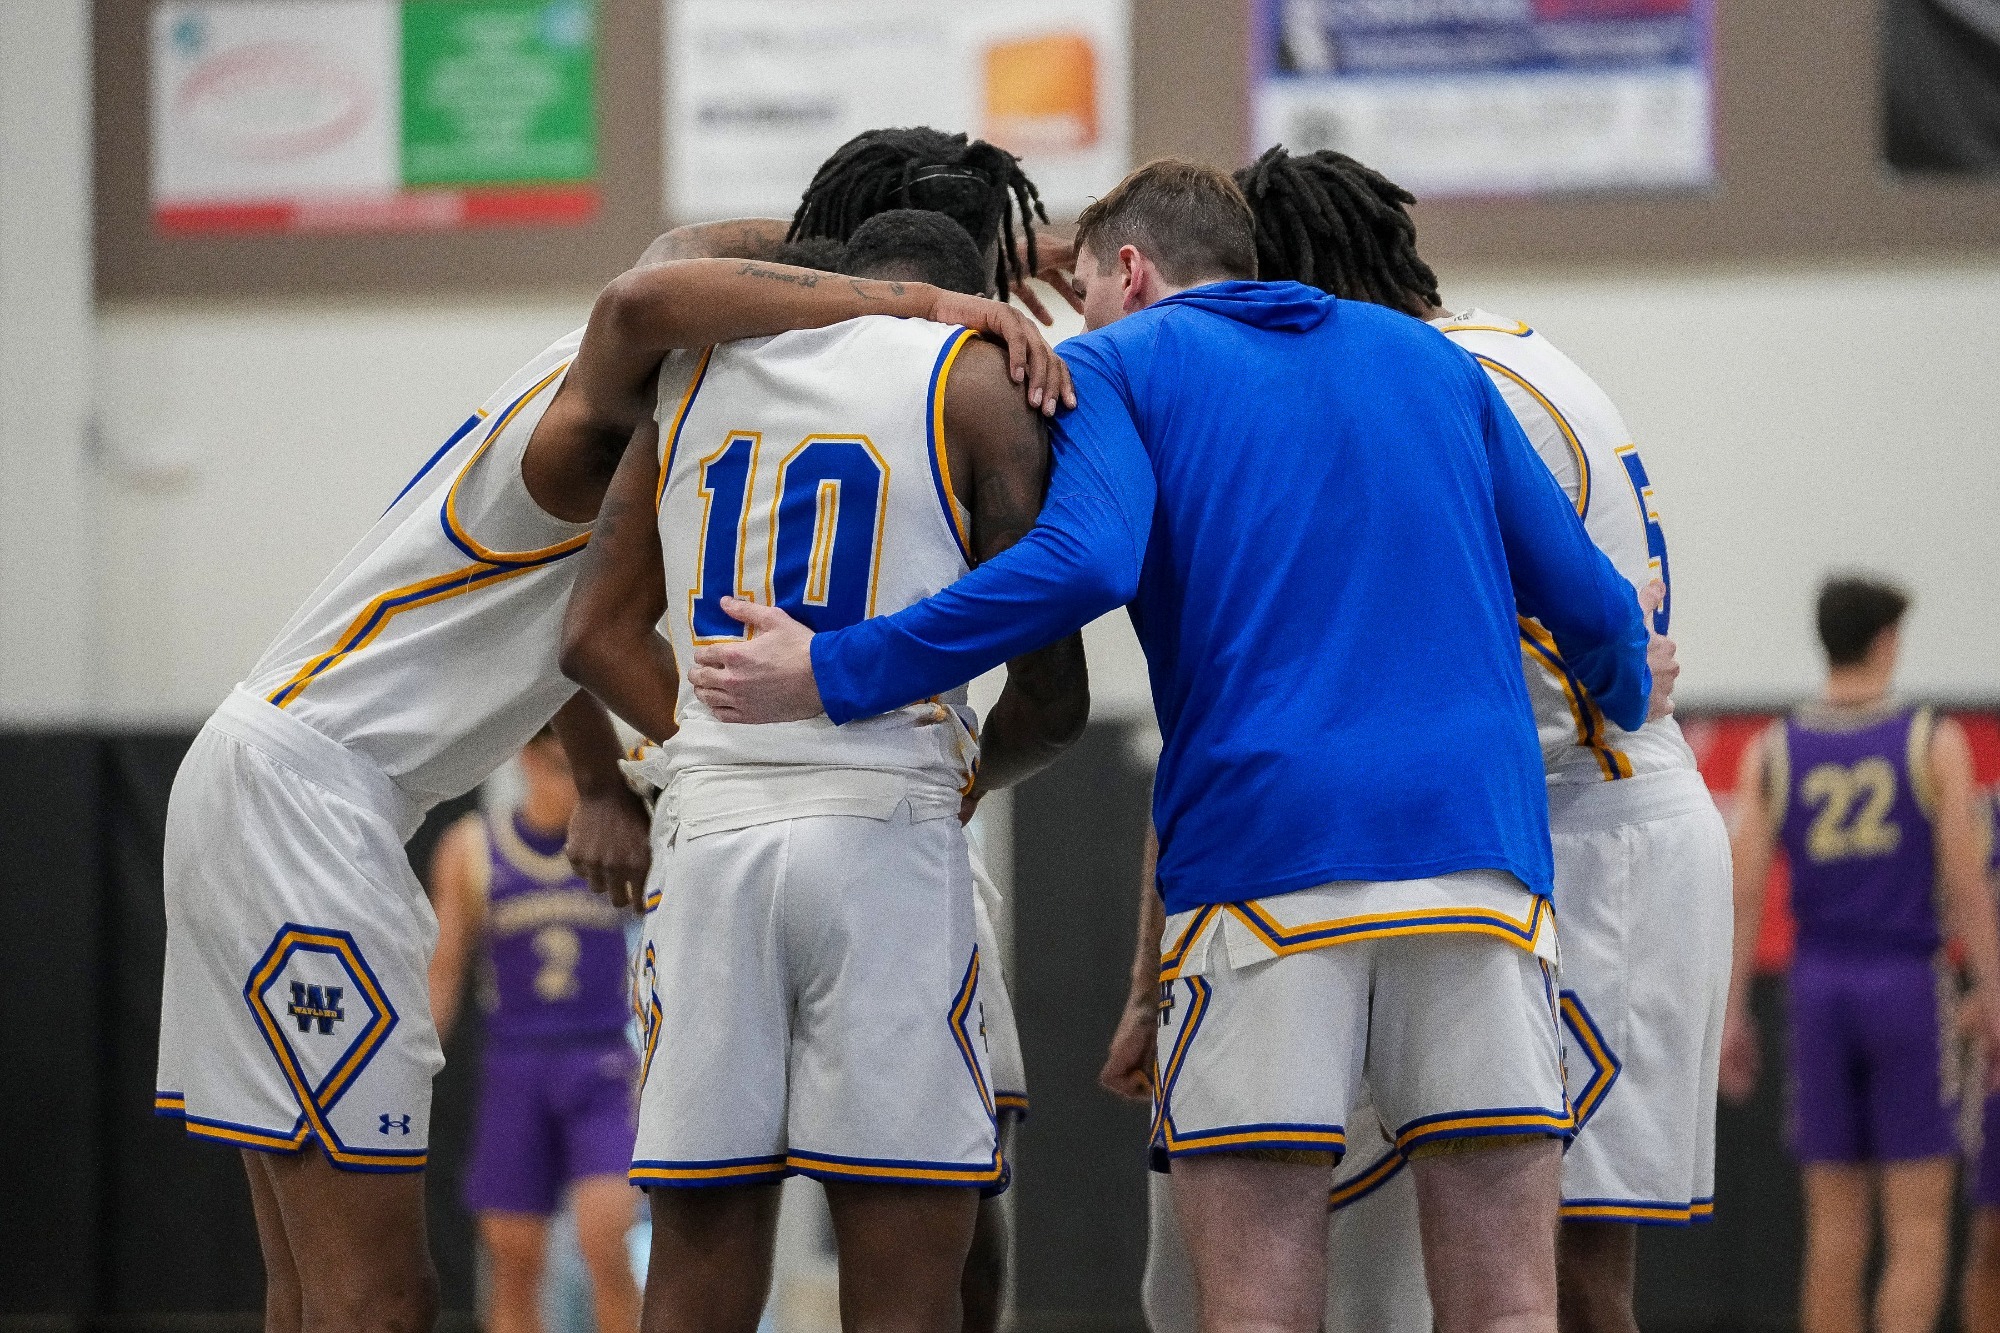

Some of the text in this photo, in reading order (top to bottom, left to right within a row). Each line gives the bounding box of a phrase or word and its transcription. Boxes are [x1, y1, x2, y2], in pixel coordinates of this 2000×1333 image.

[688, 430, 891, 646] 10
[1803, 757, 1902, 864] 22
[287, 980, 344, 1035] W
[294, 1007, 337, 1018] WAYLAND
